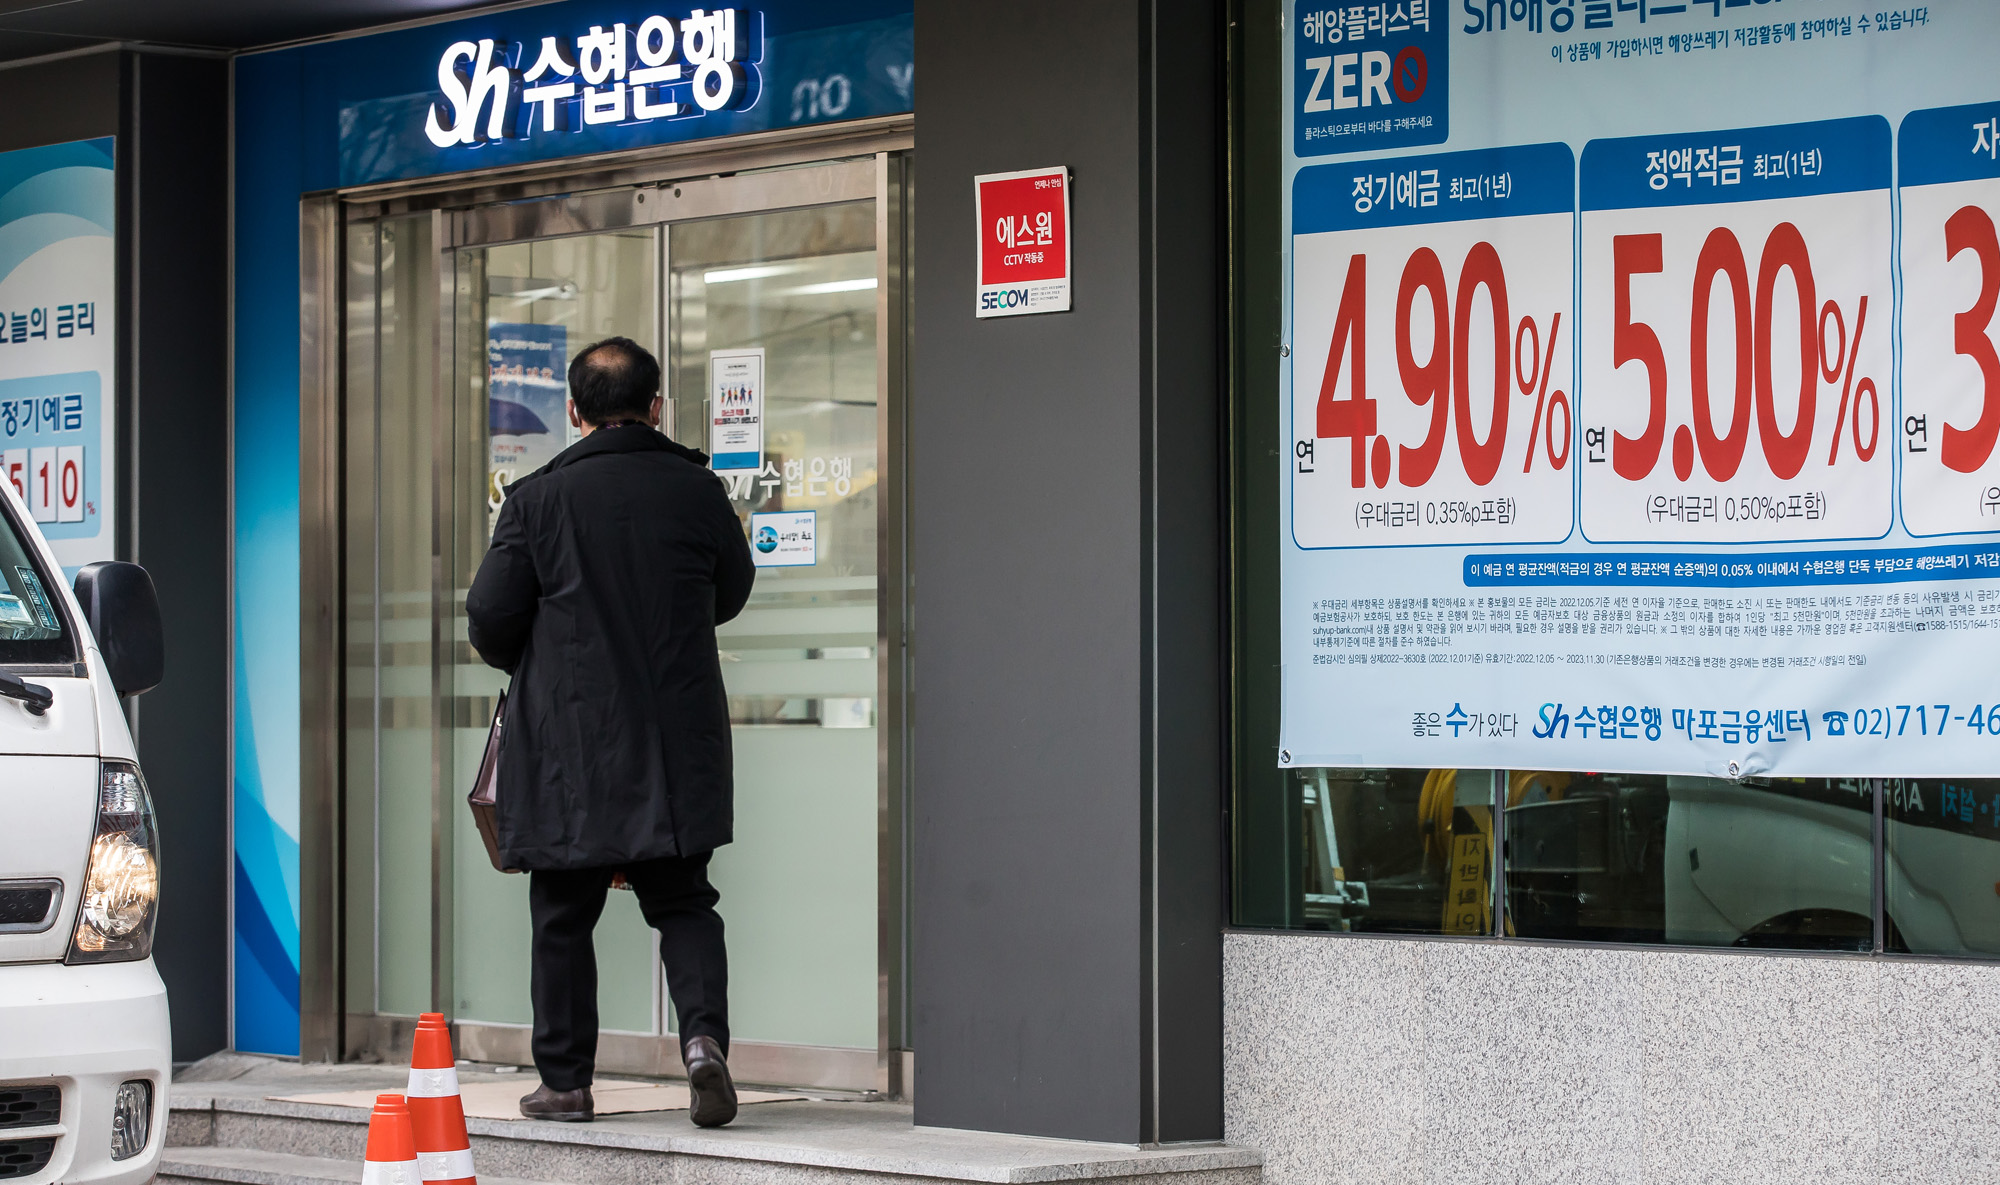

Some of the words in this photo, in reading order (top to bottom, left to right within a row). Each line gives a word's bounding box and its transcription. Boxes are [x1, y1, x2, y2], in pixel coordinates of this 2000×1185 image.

[1303, 0, 1430, 44] 해양플라스틱
[1552, 44, 1562, 63] 이
[1567, 41, 1601, 62] 상품에
[1606, 36, 1663, 58] 가입하시면
[1668, 30, 1729, 53] 해양쓰레기
[1734, 22, 1796, 47] 저감활동에
[1800, 16, 1851, 40] 참여하실
[1857, 14, 1871, 34] 수
[1875, 7, 1930, 32] 있습니다.
[522, 7, 736, 131] 수협은행
[1303, 45, 1428, 113] ZERO
[424, 38, 509, 149] Sh
[1304, 121, 1366, 140] 플라스틱으로부터
[1368, 119, 1392, 134] 바다를
[1393, 115, 1433, 131] 구해주세요
[1645, 145, 1743, 190] 정액적금
[1752, 147, 1823, 180] 최고(1년)
[1351, 168, 1441, 213] 정기예금
[1449, 172, 1512, 202] 최고(1년)
[996, 211, 1052, 248] 에스원
[1004, 254, 1023, 266] CCTV
[1024, 252, 1044, 264] 작동중
[981, 289, 1028, 310] SECOM
[57, 302, 95, 339] 금리
[1296, 438, 1315, 474] 연
[1316, 241, 1571, 489] 4.90%
[1586, 426, 1606, 463] 연
[1612, 221, 1880, 482] 5.00%
[2, 393, 83, 437] 정기예금
[1905, 413, 1927, 453] 연
[759, 455, 852, 499] 수협은행
[1355, 501, 1420, 529] (우대금리
[1426, 496, 1516, 527] 0.35%p포함)
[1646, 494, 1718, 523] (우대금리
[1725, 490, 1827, 523] 0.50%p포함)
[1470, 563, 1480, 577] 이
[1484, 562, 1502, 576] 예금
[1506, 562, 1515, 576] 연
[1518, 562, 1590, 576] 평균잔액(적금의
[1593, 562, 1613, 576] 경우
[1616, 562, 1627, 576] 연
[1630, 562, 1670, 576] 평균잔액
[1674, 562, 1718, 577] 순증액)의
[1721, 564, 1754, 577] 0.05%
[1757, 562, 1799, 576] 이내에서
[1802, 560, 1845, 575] 수협은행
[1849, 559, 1870, 574] 단독
[1874, 558, 1913, 573] 부담으로
[1916, 553, 1970, 572] 해양쓰레기
[1313, 612, 1360, 622] 예금보험공사가
[1396, 612, 1409, 621] 보호
[1413, 611, 1433, 621] 한도는
[1472, 610, 1486, 620] 있는
[1515, 610, 1529, 620] 모든
[1533, 610, 1570, 620] 예금자보호
[1574, 610, 1588, 620] 대상
[1592, 610, 1632, 621] 금융상품의
[1636, 611, 1659, 622] 원금과
[1664, 611, 1685, 622] 소정의
[1690, 612, 1714, 622] 이자를
[1718, 612, 1740, 623] 합하여
[1916, 606, 1944, 617] 나머지
[1949, 604, 1976, 616] 금액은
[1321, 600, 1348, 610] 우대금리
[1351, 599, 1385, 609] 세부항목은
[1388, 598, 1428, 609] 상품설명서를
[1432, 598, 1466, 608] 확인하세요
[1518, 597, 1532, 606] 모든
[1536, 597, 1557, 607] 금리는
[1642, 597, 1665, 608] 이자율
[1923, 591, 1960, 603] 사유발생
[1313, 637, 1360, 647] 내부통제기준에
[1362, 636, 1376, 647] 따른
[1378, 636, 1398, 647] 절차를
[1401, 636, 1414, 646] 준수
[1377, 624, 1390, 635] 상품
[1393, 624, 1413, 634] 설명서
[1426, 623, 1446, 634] 약관을
[1466, 623, 1486, 633] 보시기
[1516, 623, 1537, 633] 필요한
[1540, 623, 1554, 633] 경우
[1558, 623, 1578, 634] 설명을
[1699, 625, 1722, 636] 상품에
[1725, 626, 1740, 637] 대한
[1744, 625, 1767, 636] 자세한
[1797, 624, 1821, 635] 가까운
[1412, 712, 1442, 737] 좋은
[1446, 702, 1485, 738] 수가
[1488, 712, 1518, 738] 있다
[1532, 702, 1570, 738] Sh
[1574, 704, 1663, 742] 수협은행
[1671, 708, 1811, 744] 마포금융센터
